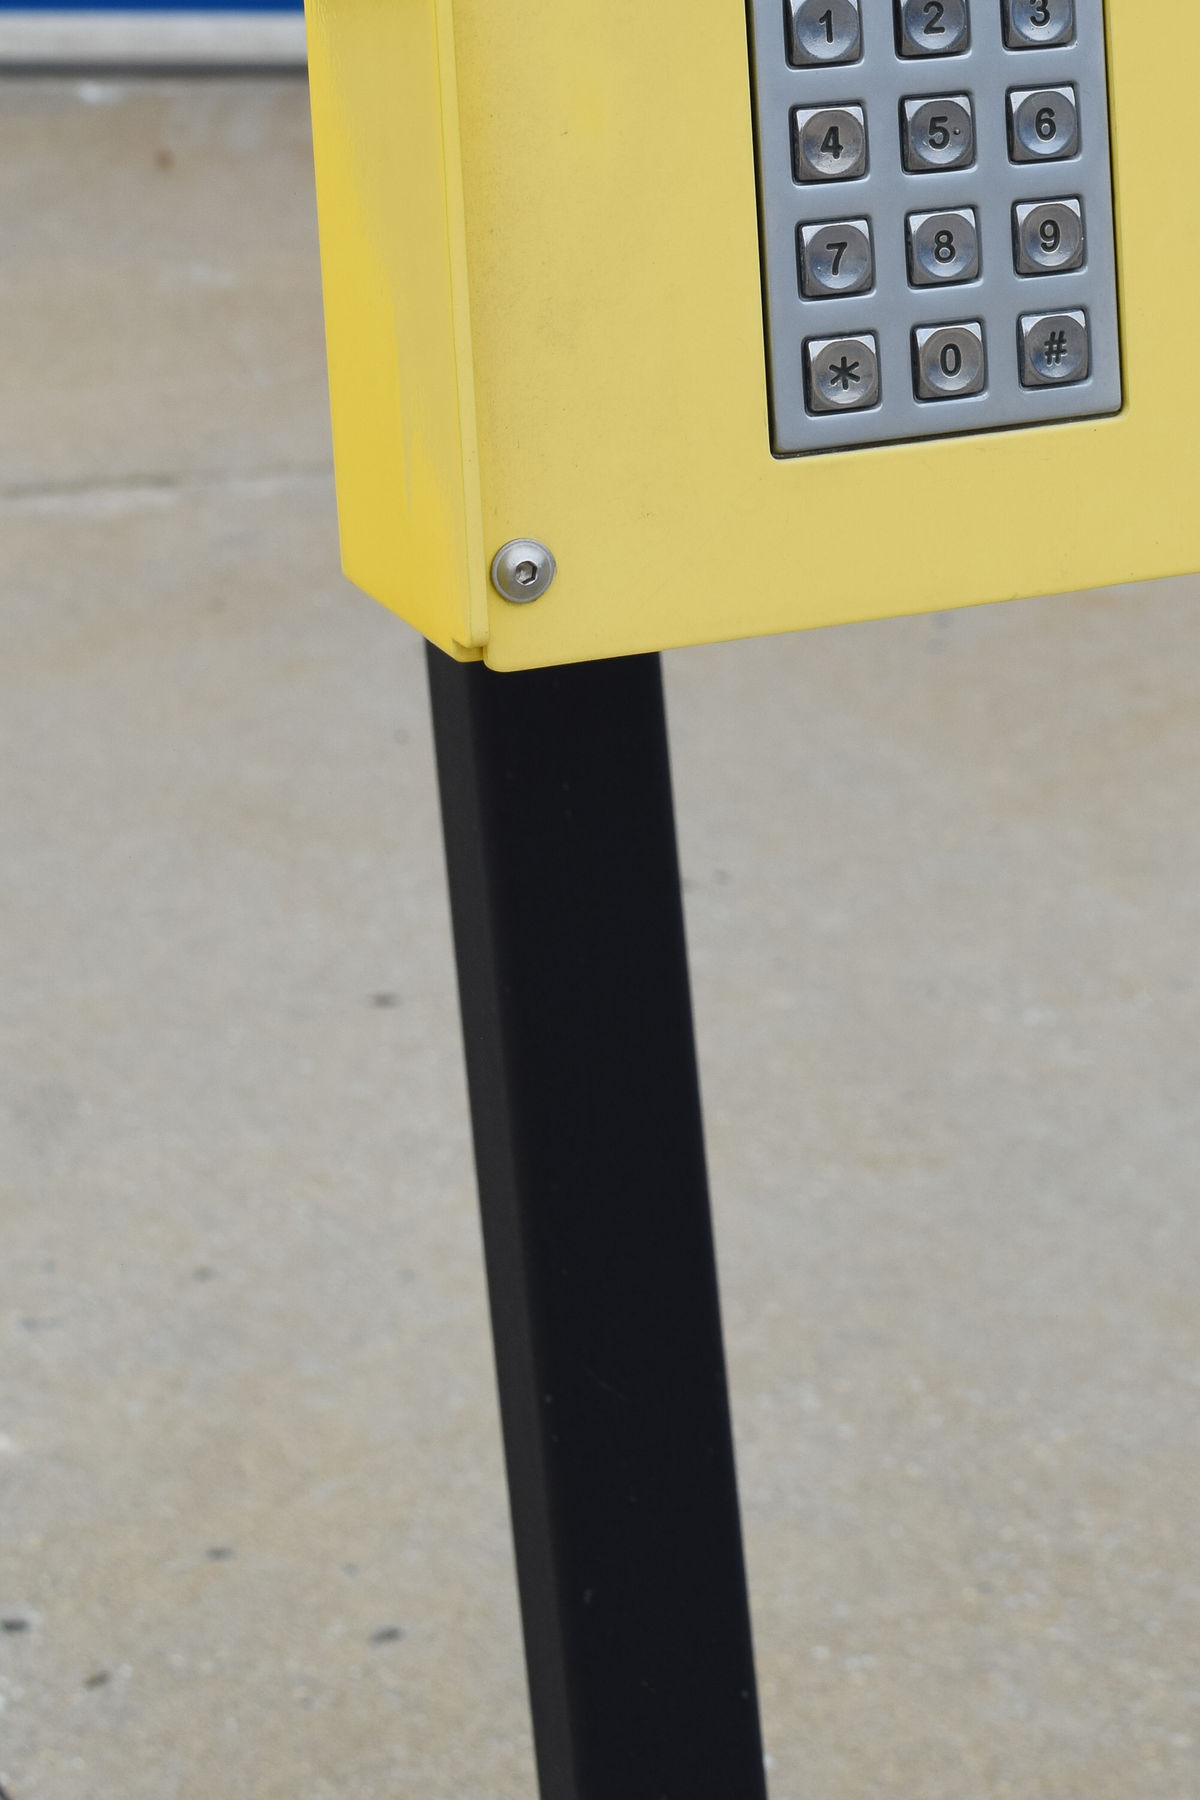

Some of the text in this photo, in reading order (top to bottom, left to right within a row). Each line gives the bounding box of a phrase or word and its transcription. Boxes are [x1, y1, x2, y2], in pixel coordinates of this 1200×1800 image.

[818, 8, 834, 44] 1
[922, 0, 946, 35] 2
[819, 106, 1057, 160] 4 5 6
[825, 219, 1062, 277] 7 8 9
[939, 343, 962, 378] 0
